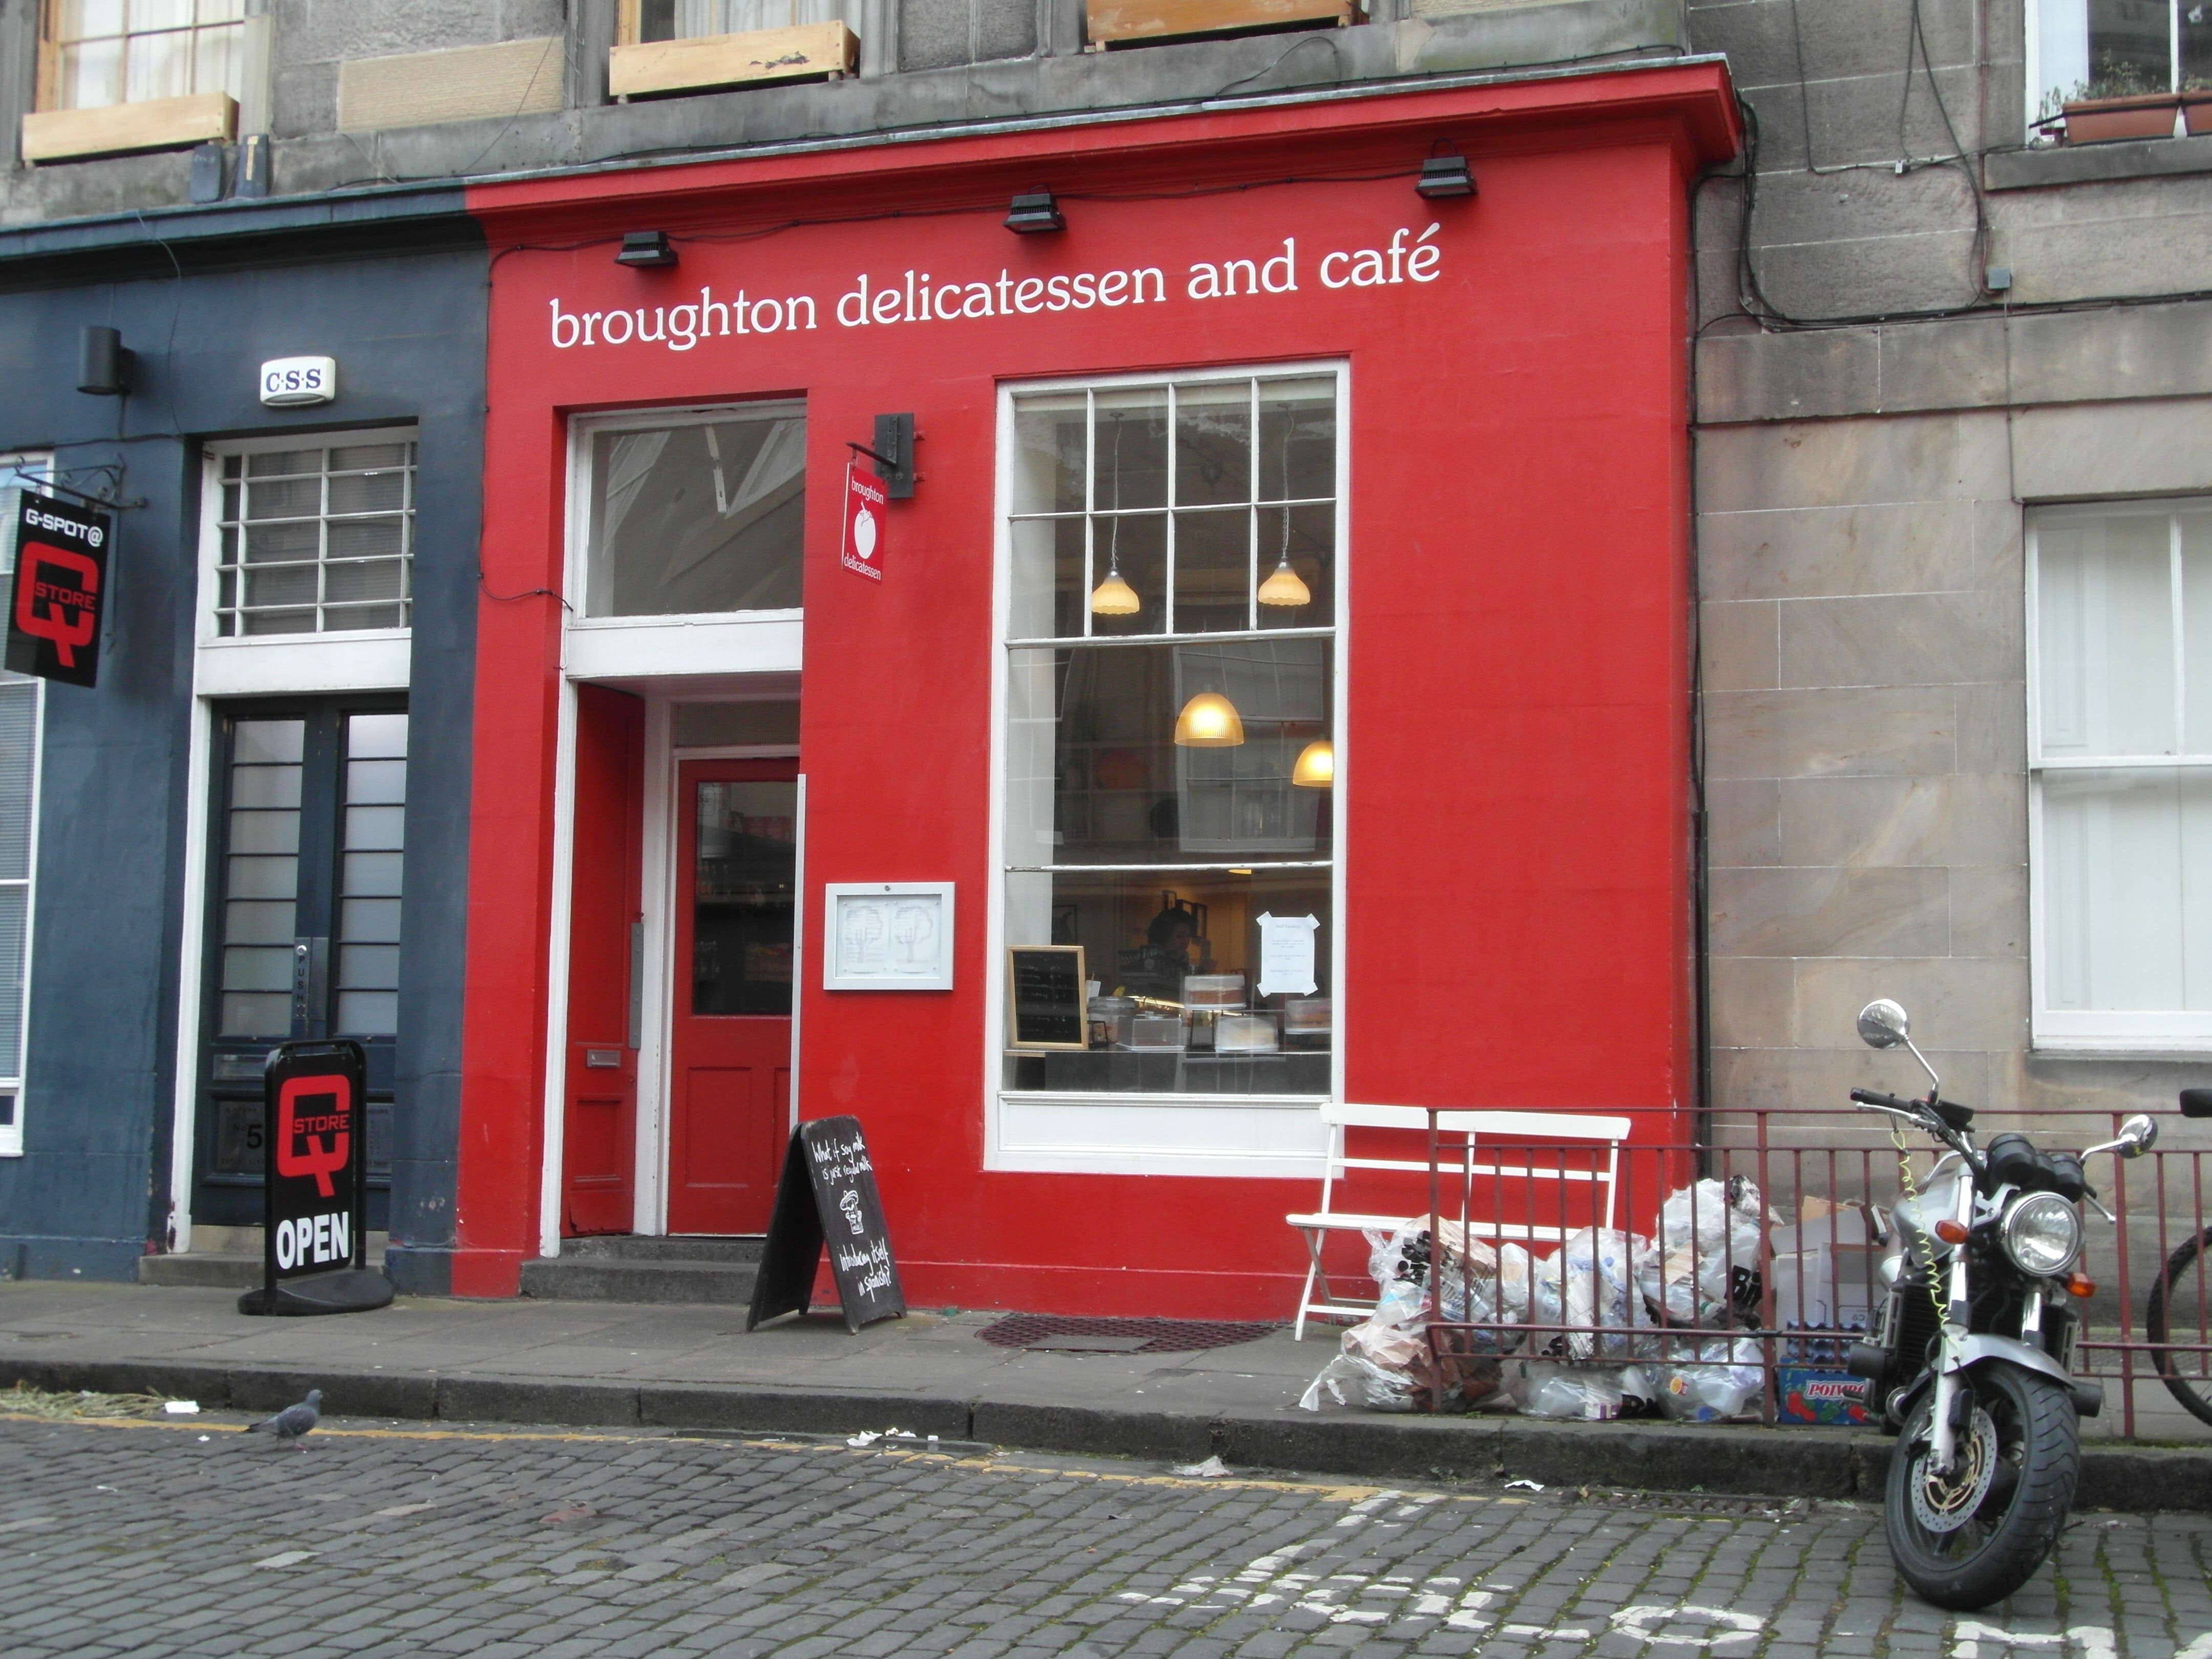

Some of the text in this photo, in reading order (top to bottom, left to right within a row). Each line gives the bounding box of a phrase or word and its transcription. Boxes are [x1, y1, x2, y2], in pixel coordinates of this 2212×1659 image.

[549, 222, 1441, 351] broughton delicatessen and café
[851, 476, 884, 505] broughton
[25, 507, 103, 547] G-SPOT@
[843, 552, 882, 581] delicatessen
[34, 581, 97, 610] STORE
[296, 955, 305, 1002] PUSH
[293, 1114, 350, 1134] STORE
[811, 1139, 832, 1163] What
[821, 1165, 829, 1180] is
[828, 1165, 842, 1186] just
[276, 1211, 349, 1270] OPEN
[870, 1237, 890, 1267] itself
[856, 1276, 865, 1297] in
